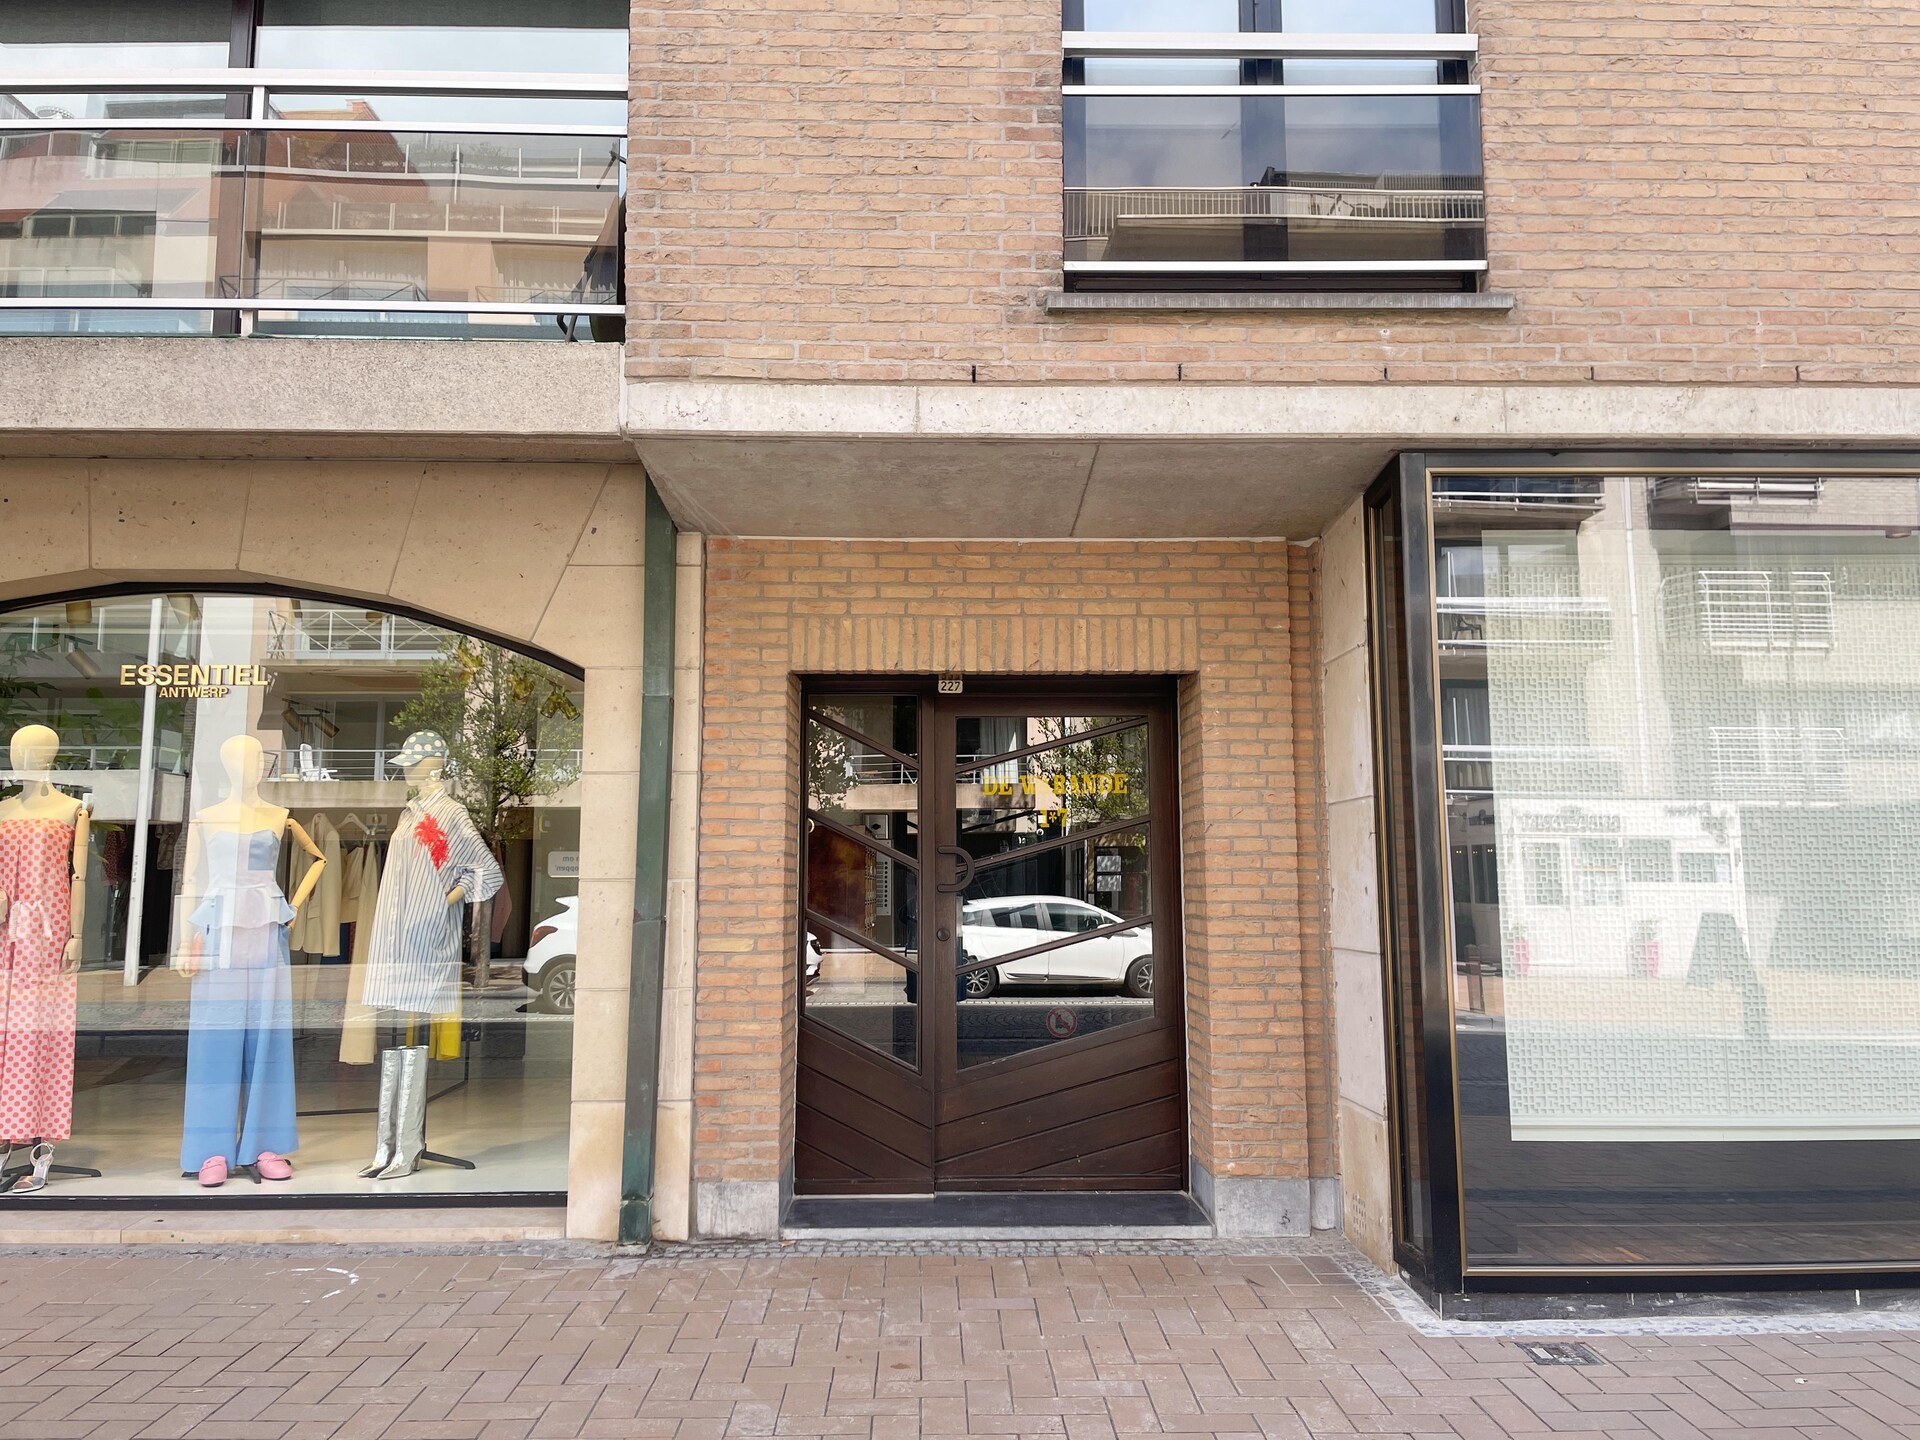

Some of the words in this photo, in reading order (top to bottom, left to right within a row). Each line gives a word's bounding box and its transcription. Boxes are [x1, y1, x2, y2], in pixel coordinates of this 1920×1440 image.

[120, 664, 269, 686] ESSENTIEL
[158, 686, 229, 698] ANTWERP
[940, 681, 960, 692] 227
[983, 773, 1013, 796] DE
